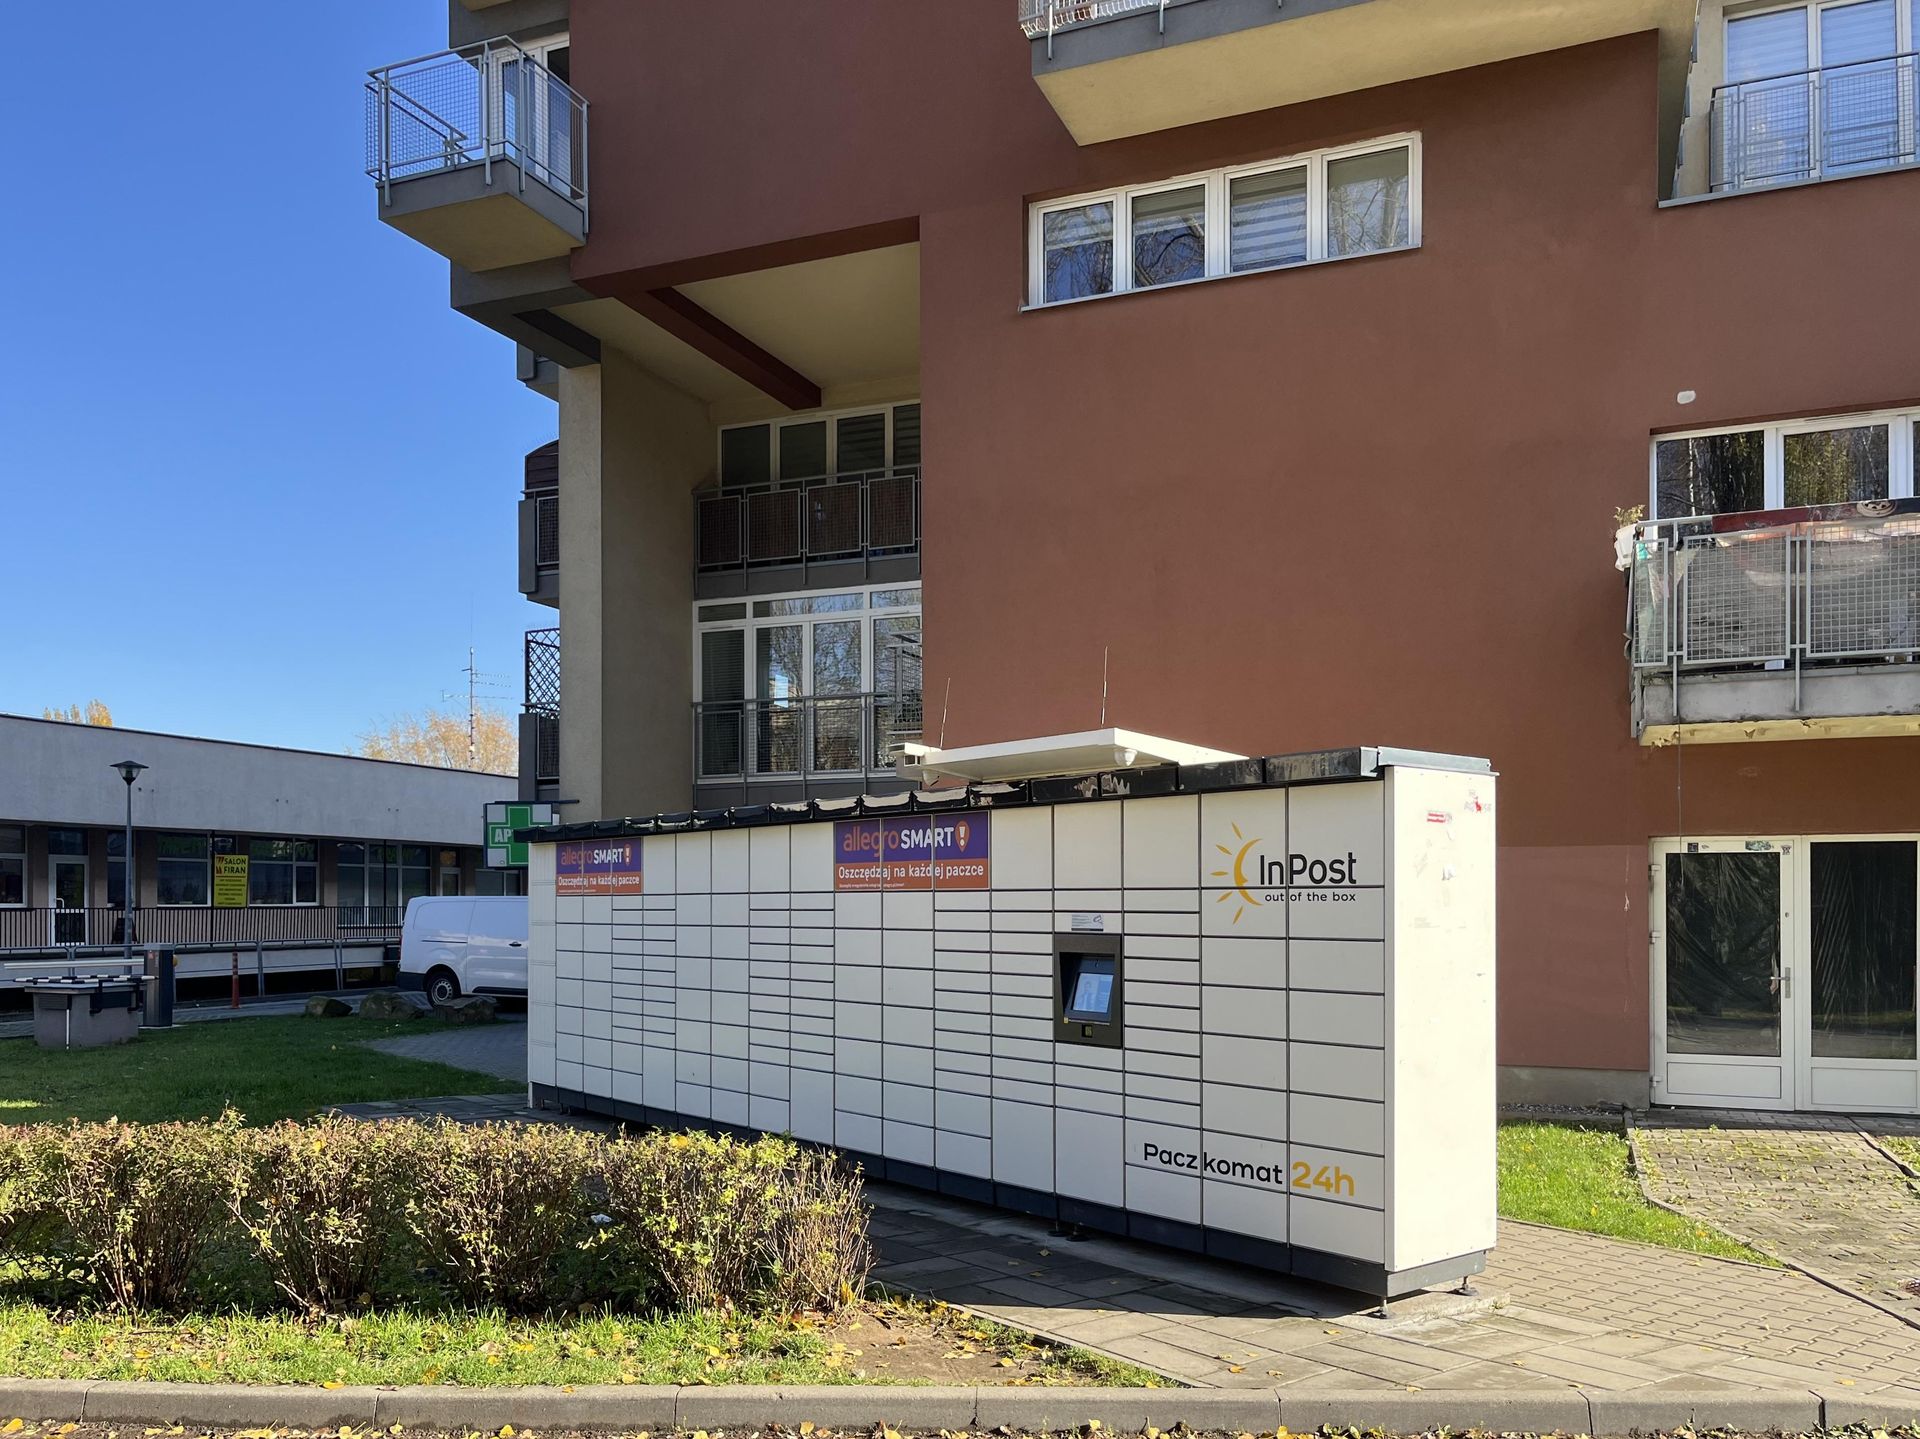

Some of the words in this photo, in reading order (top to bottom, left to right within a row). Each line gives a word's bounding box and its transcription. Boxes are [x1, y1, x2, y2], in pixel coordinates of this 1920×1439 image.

[224, 857, 246, 865] SALON
[224, 866, 246, 874] FIRAN
[838, 865, 891, 881] Oszczędzaj
[894, 868, 906, 878] na
[908, 864, 944, 879] każdej
[946, 864, 984, 879] paczce
[1259, 851, 1357, 886] InPost
[590, 876, 597, 885] na
[619, 874, 640, 887] paczce
[1264, 892, 1285, 902] out
[1290, 891, 1302, 902] of
[1306, 891, 1328, 902] the
[1332, 891, 1356, 902] box
[1143, 1142, 1283, 1185] Paczkomat
[1292, 1161, 1355, 1197] 24h
